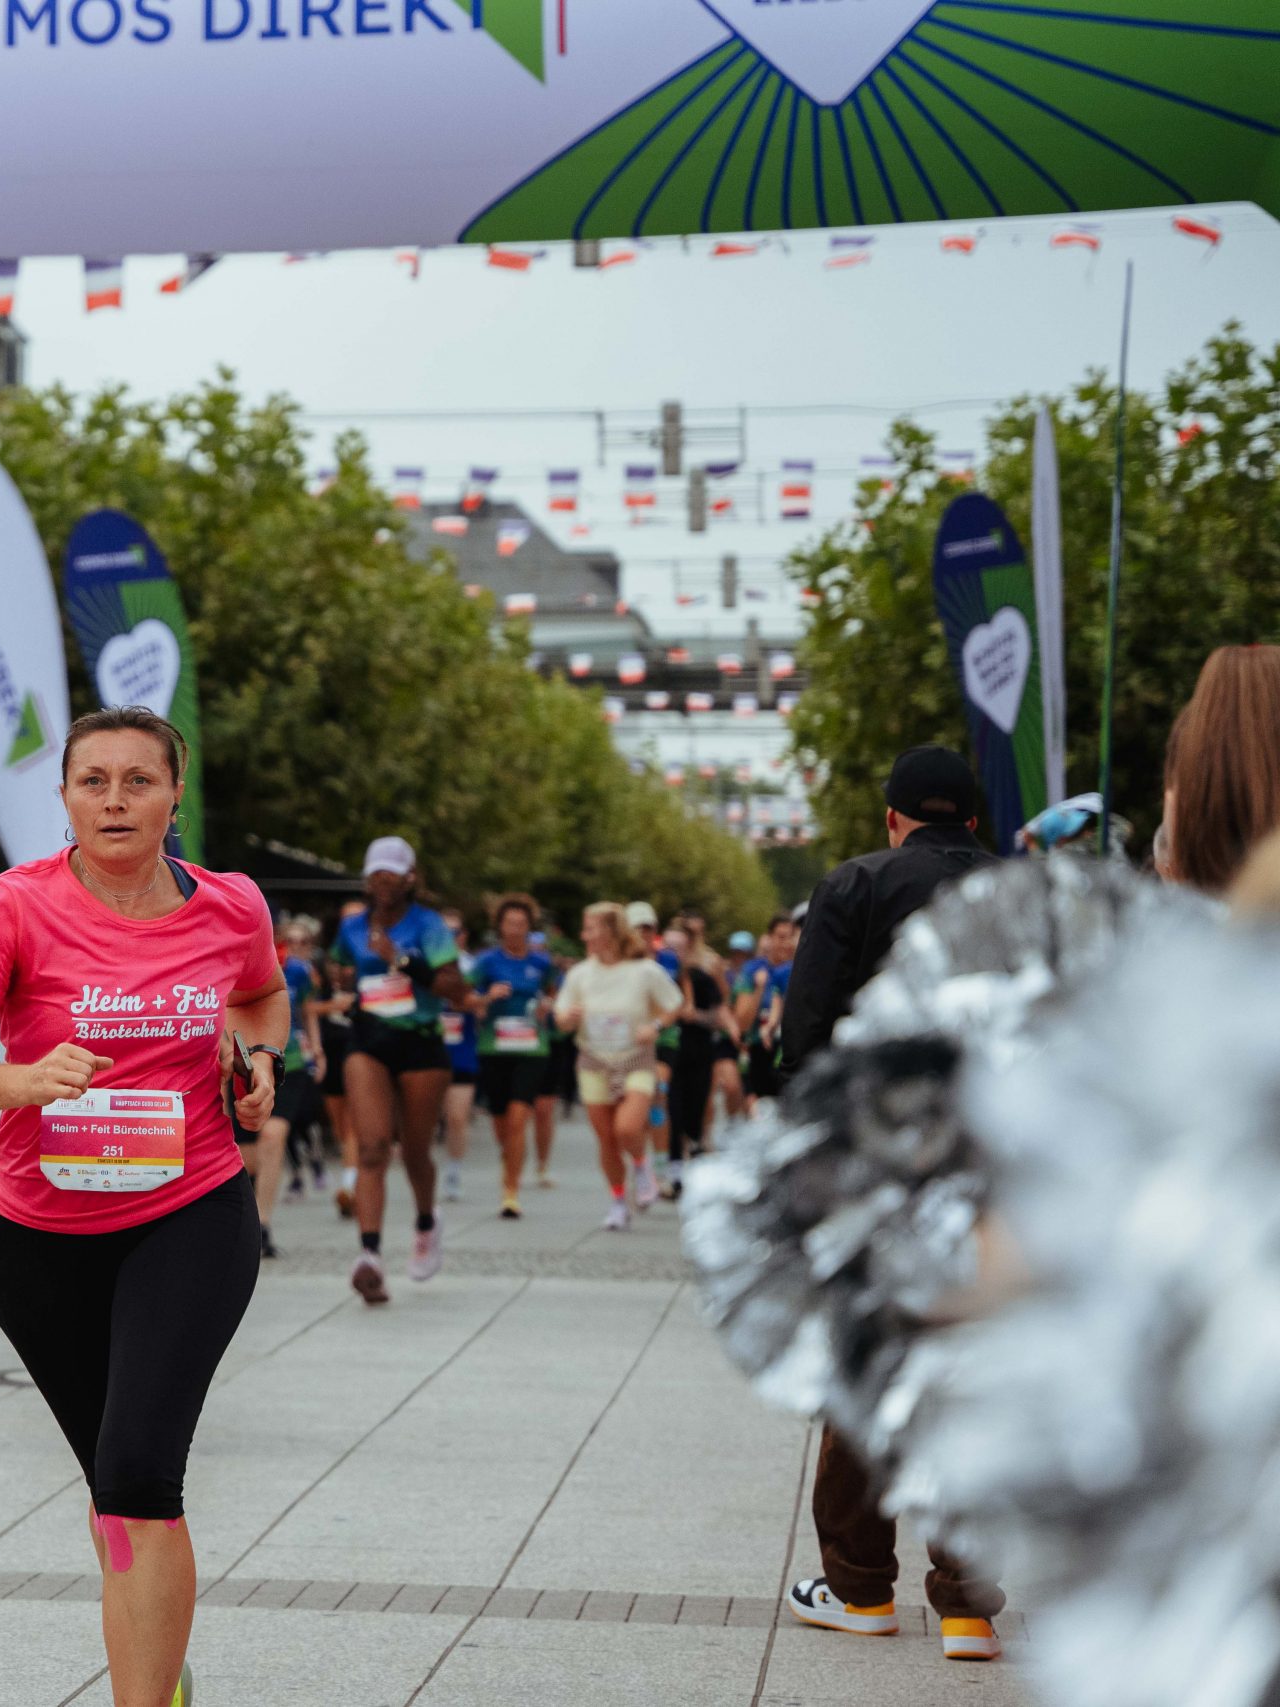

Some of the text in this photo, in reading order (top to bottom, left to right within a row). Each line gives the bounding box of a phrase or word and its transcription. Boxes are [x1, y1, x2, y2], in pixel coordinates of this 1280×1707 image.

[71, 984, 219, 1014] Heim + Feit
[75, 1020, 177, 1040] Bürotechnik
[51, 1123, 78, 1133] Heim
[90, 1124, 110, 1134] Feit
[113, 1125, 176, 1136] Bürotechnik
[102, 1145, 123, 1157] 251
